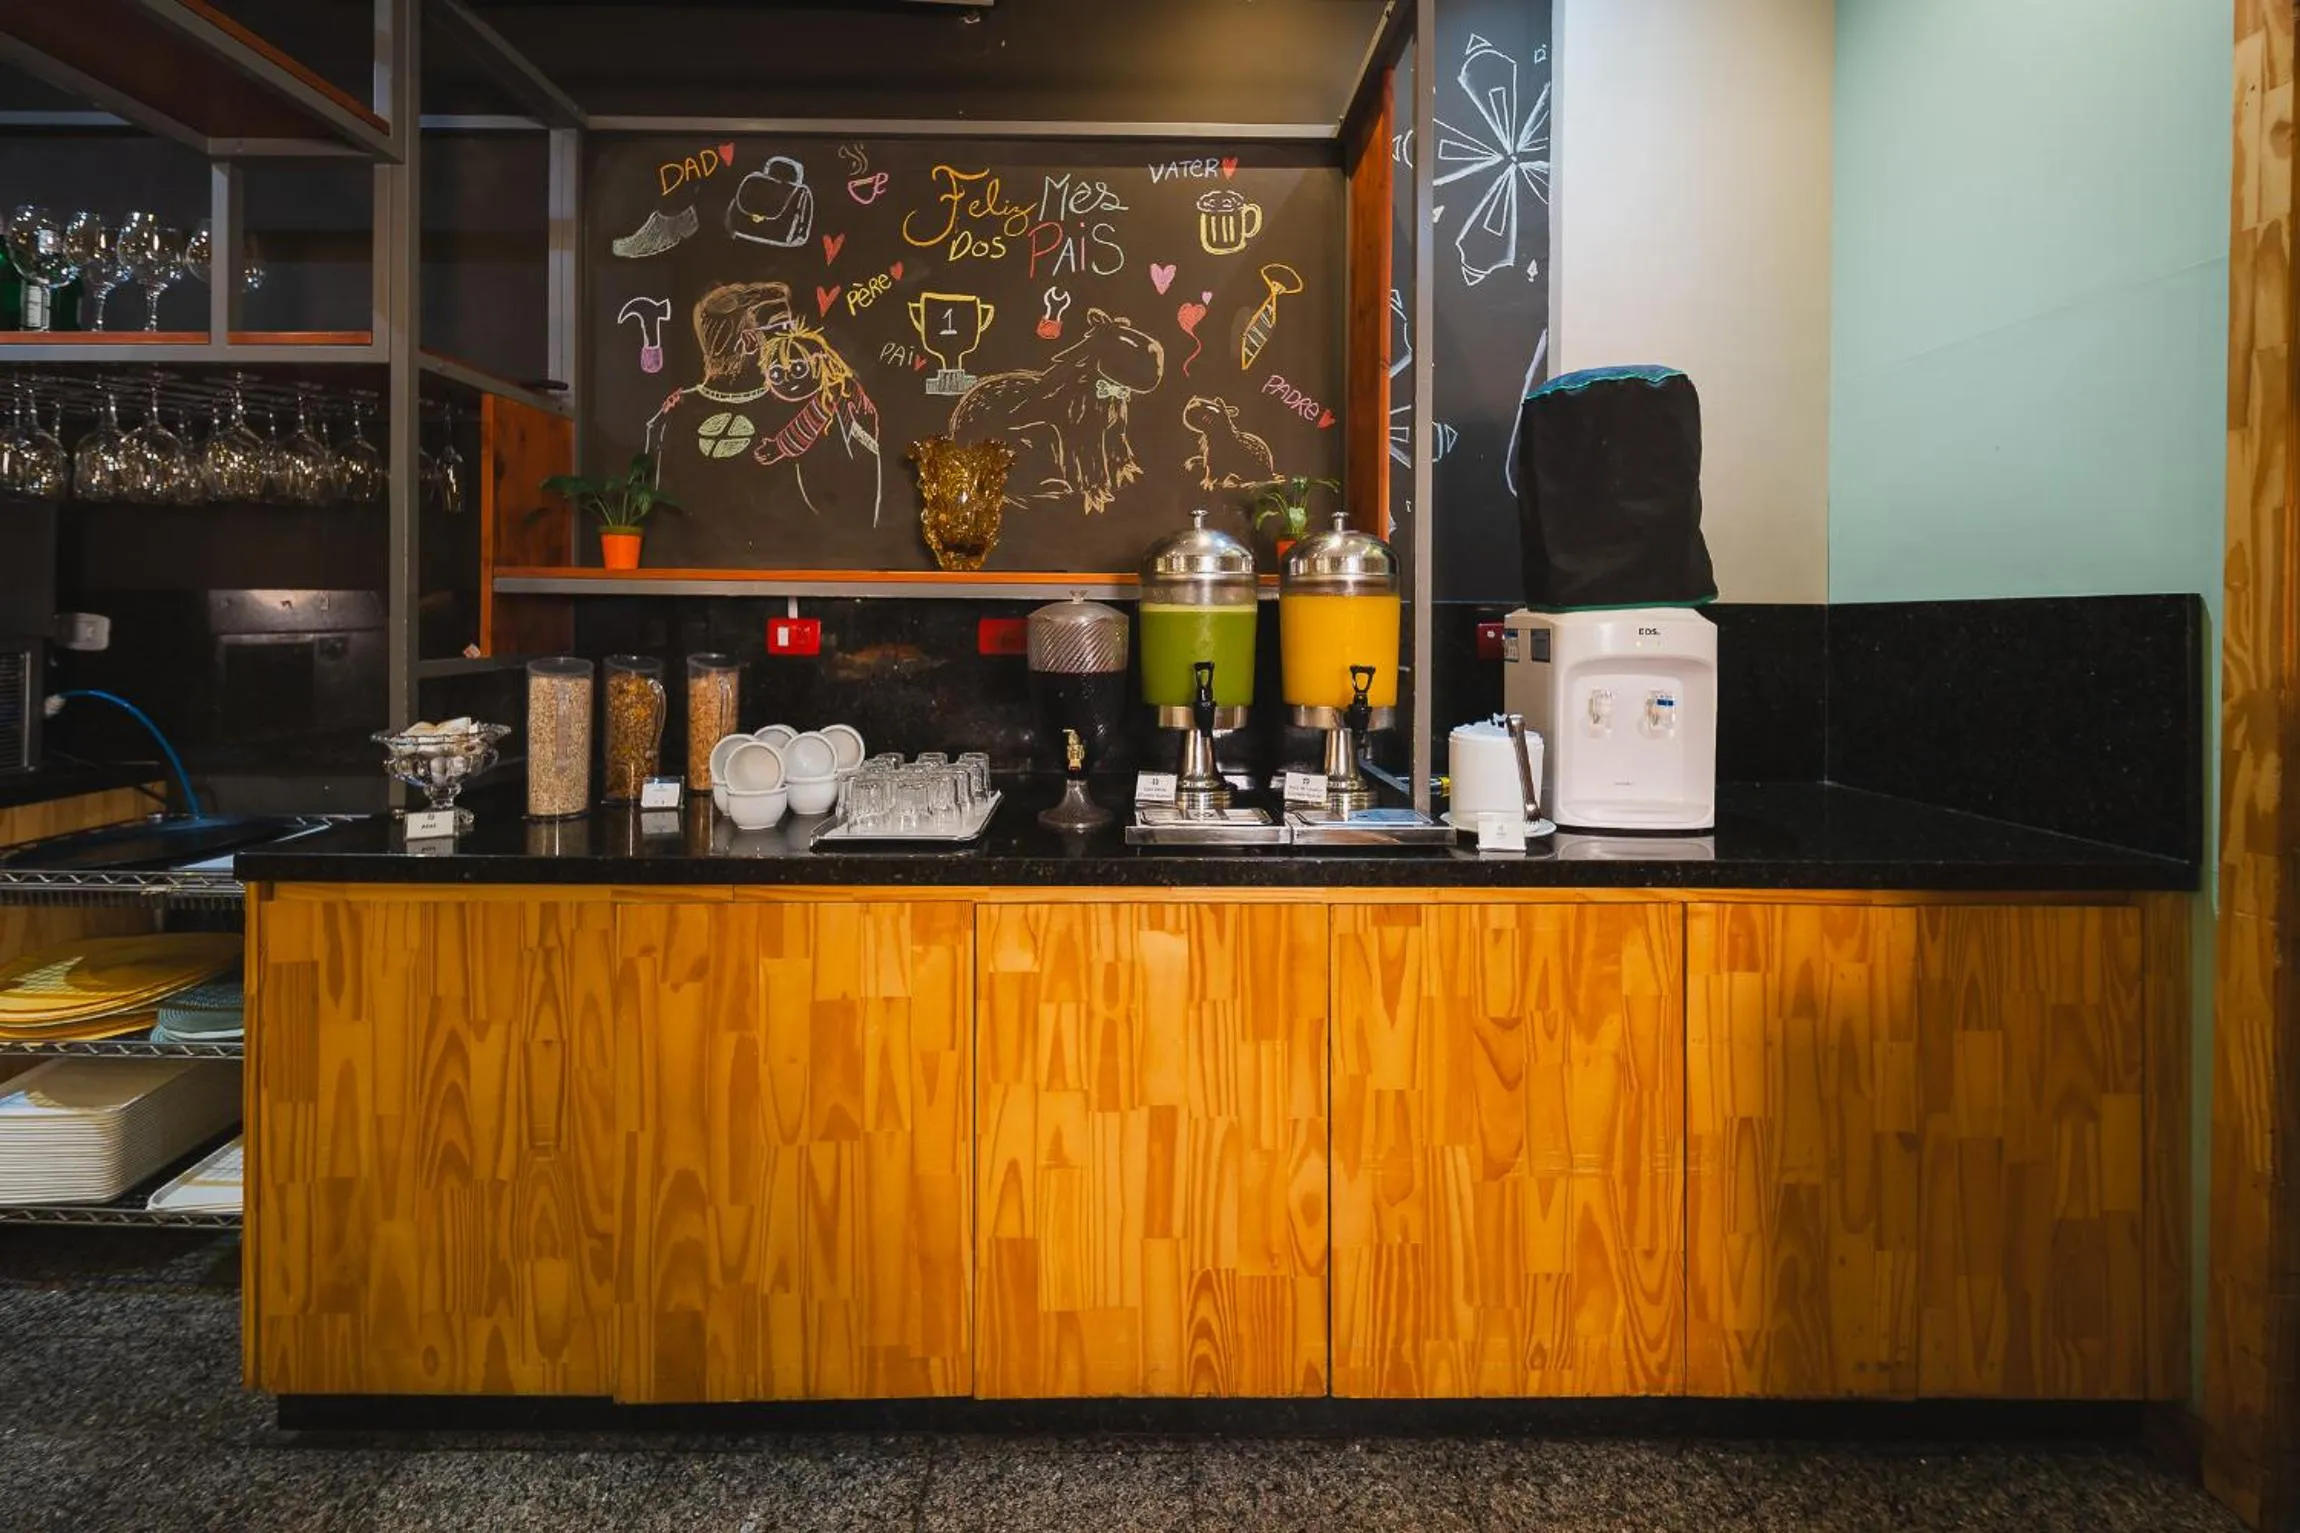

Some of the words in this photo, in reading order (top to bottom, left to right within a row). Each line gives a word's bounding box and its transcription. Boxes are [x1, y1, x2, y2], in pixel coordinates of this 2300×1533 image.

[660, 149, 719, 196] DAD
[902, 164, 1038, 247] Feliz
[938, 307, 958, 335] 1
